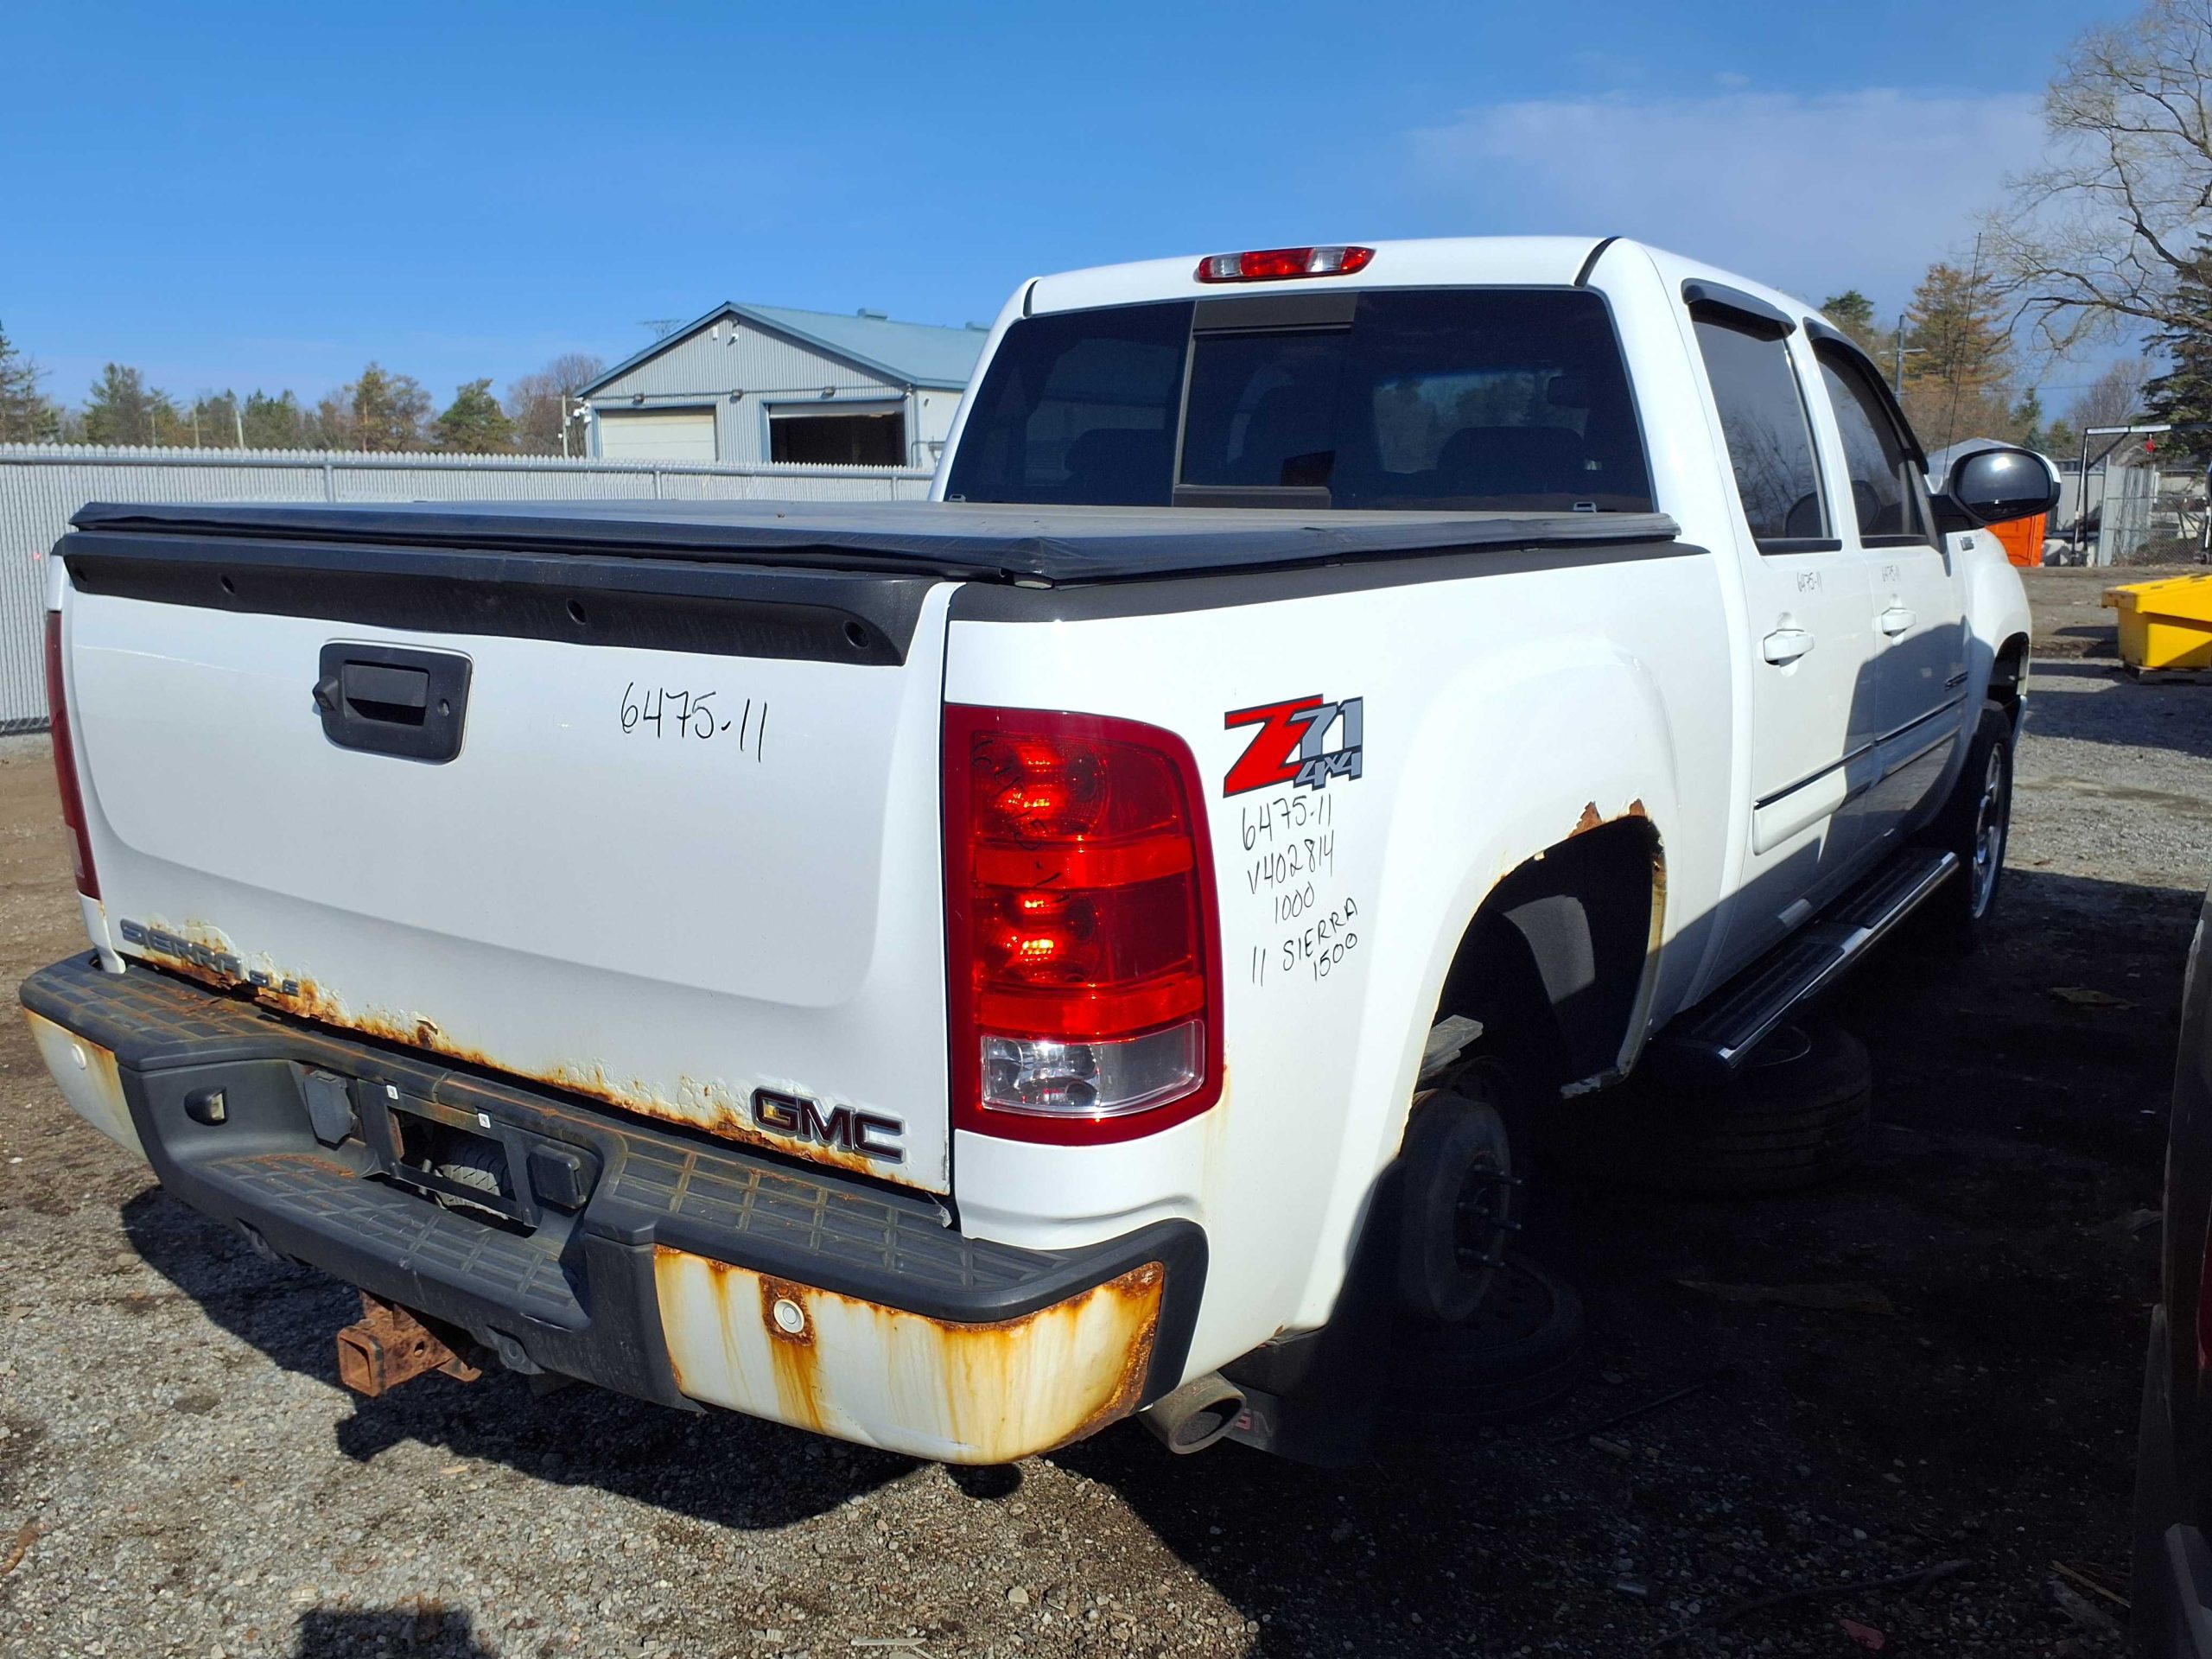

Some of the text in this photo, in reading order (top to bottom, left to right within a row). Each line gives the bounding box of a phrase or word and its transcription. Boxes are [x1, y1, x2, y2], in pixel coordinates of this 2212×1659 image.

[1223, 694, 1364, 798] Z71
[1274, 880, 1315, 925] 1000
[1282, 897, 1359, 971] SIERRA
[120, 918, 246, 982] SIERRA
[1313, 932, 1358, 982] 1500
[750, 1085, 907, 1165] GMC
